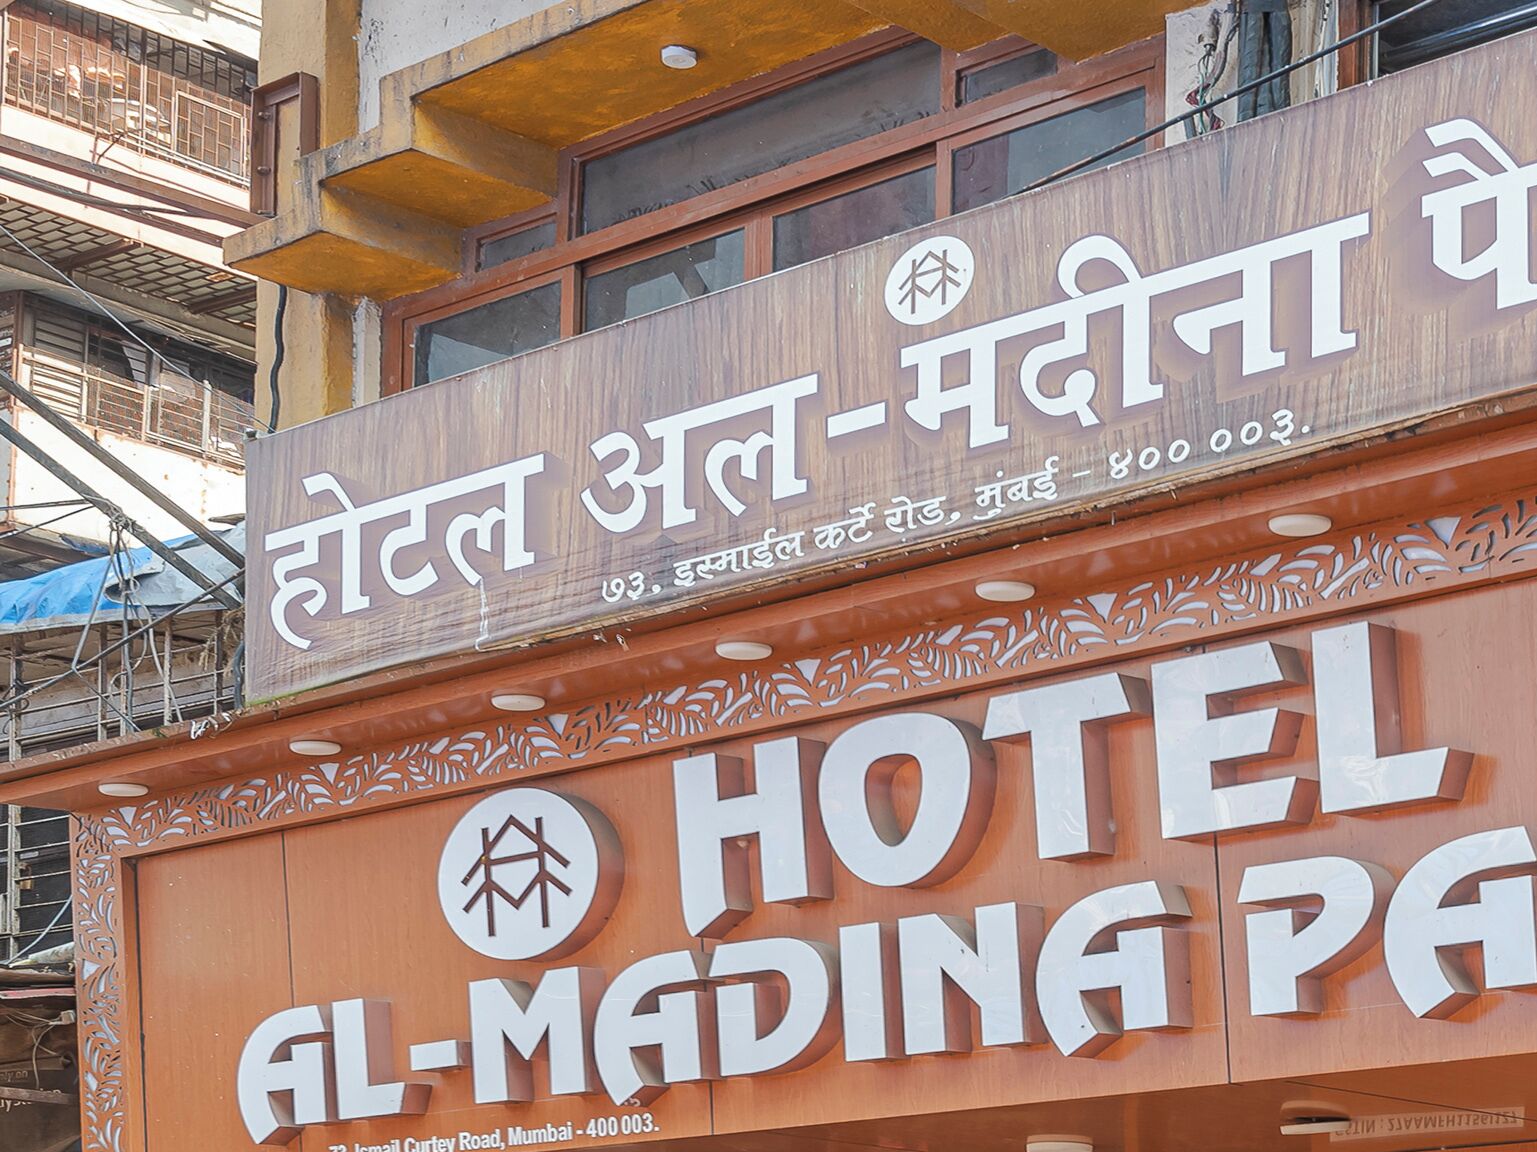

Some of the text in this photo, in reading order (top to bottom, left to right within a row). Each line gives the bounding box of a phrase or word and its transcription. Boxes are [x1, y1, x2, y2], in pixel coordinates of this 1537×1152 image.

[264, 454, 546, 649] होटल
[673, 528, 805, 587] इस्माईल
[973, 455, 1059, 520] मुंबई
[1109, 439, 1191, 480] ४००
[673, 621, 1470, 938] HOTEL
[237, 881, 1191, 1145] AL-MADINA
[458, 1129, 504, 1151] Road,
[507, 1122, 573, 1146] Mumbai
[586, 1117, 618, 1138] 400
[621, 1112, 660, 1135] 003.
